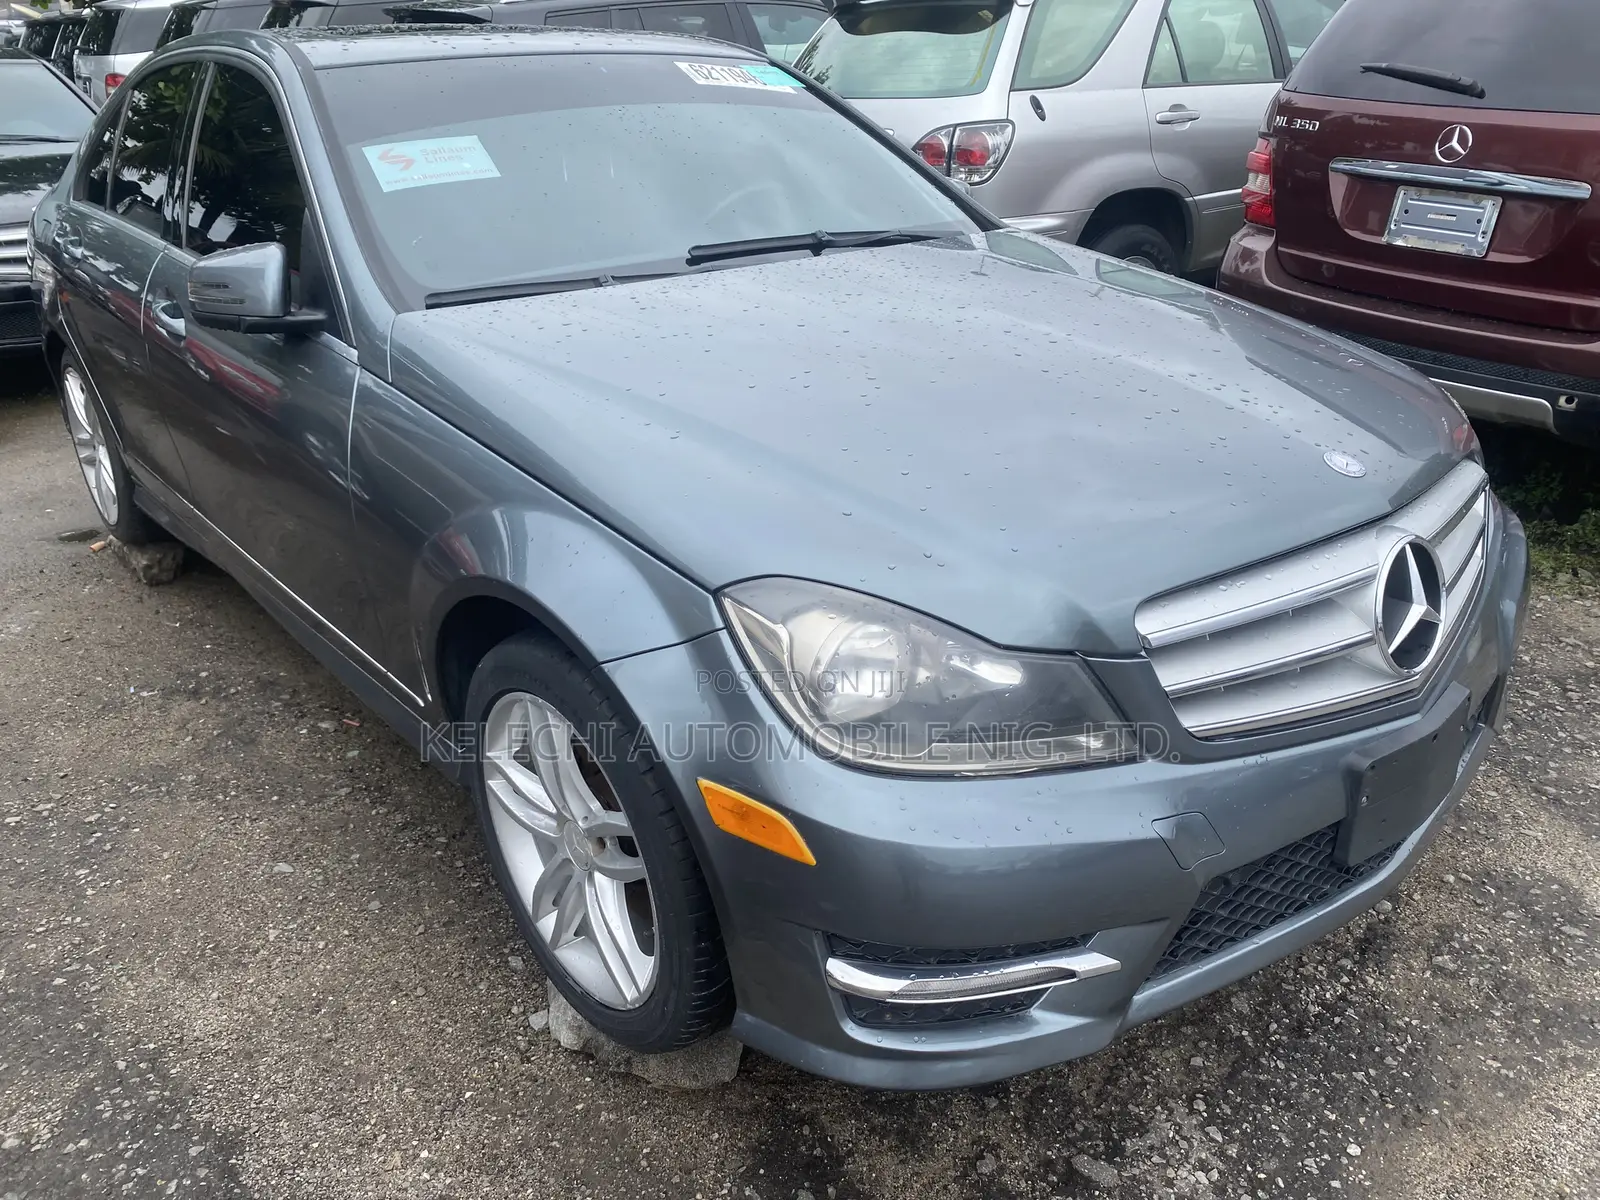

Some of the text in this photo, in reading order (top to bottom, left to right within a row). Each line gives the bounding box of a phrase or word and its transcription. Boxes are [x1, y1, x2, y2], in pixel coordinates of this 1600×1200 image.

[1290, 118, 1320, 131] 350
[419, 144, 477, 157] Sallaum
[424, 152, 465, 165] Lines
